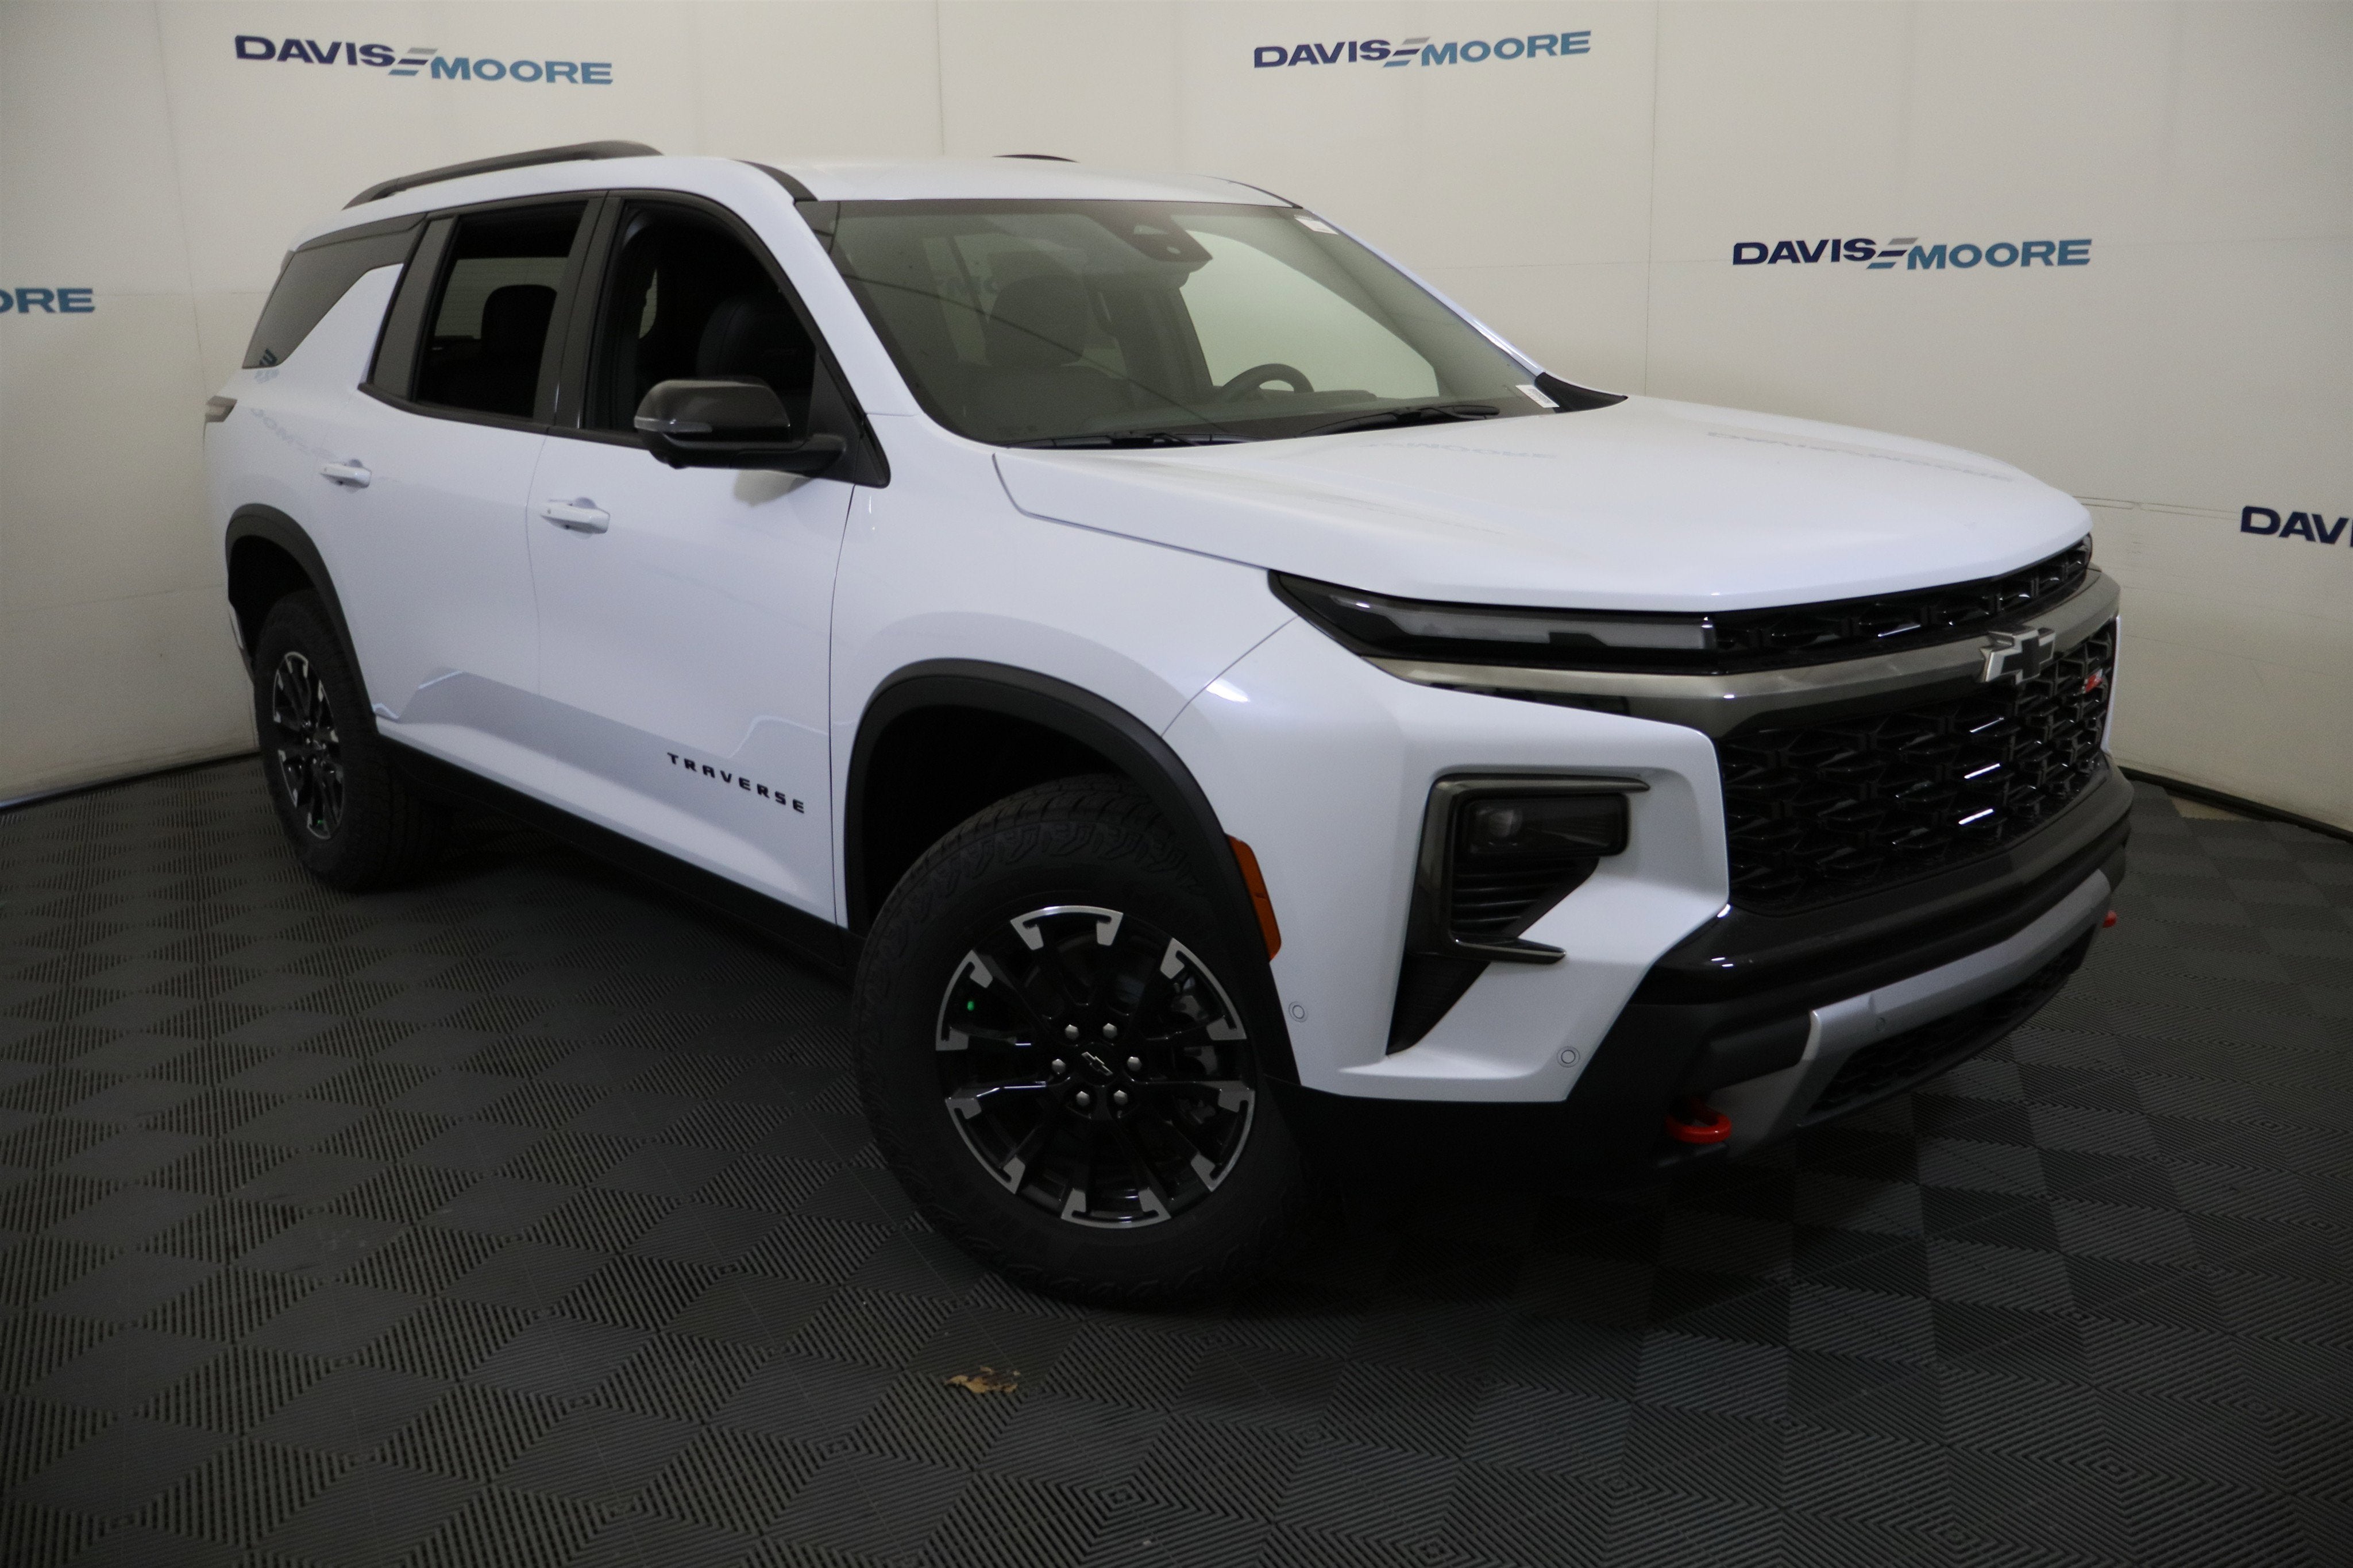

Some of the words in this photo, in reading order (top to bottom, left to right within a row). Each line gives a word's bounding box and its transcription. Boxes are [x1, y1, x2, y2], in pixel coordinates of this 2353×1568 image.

[234, 34, 396, 67] DAVIS
[430, 56, 613, 84] MOORE
[1253, 39, 1391, 68] DAVIS
[1421, 30, 1591, 66] MOORE
[1733, 238, 1876, 265] DAVIS
[1907, 239, 2092, 270] MOORE
[667, 752, 804, 814] TRAVERSE
